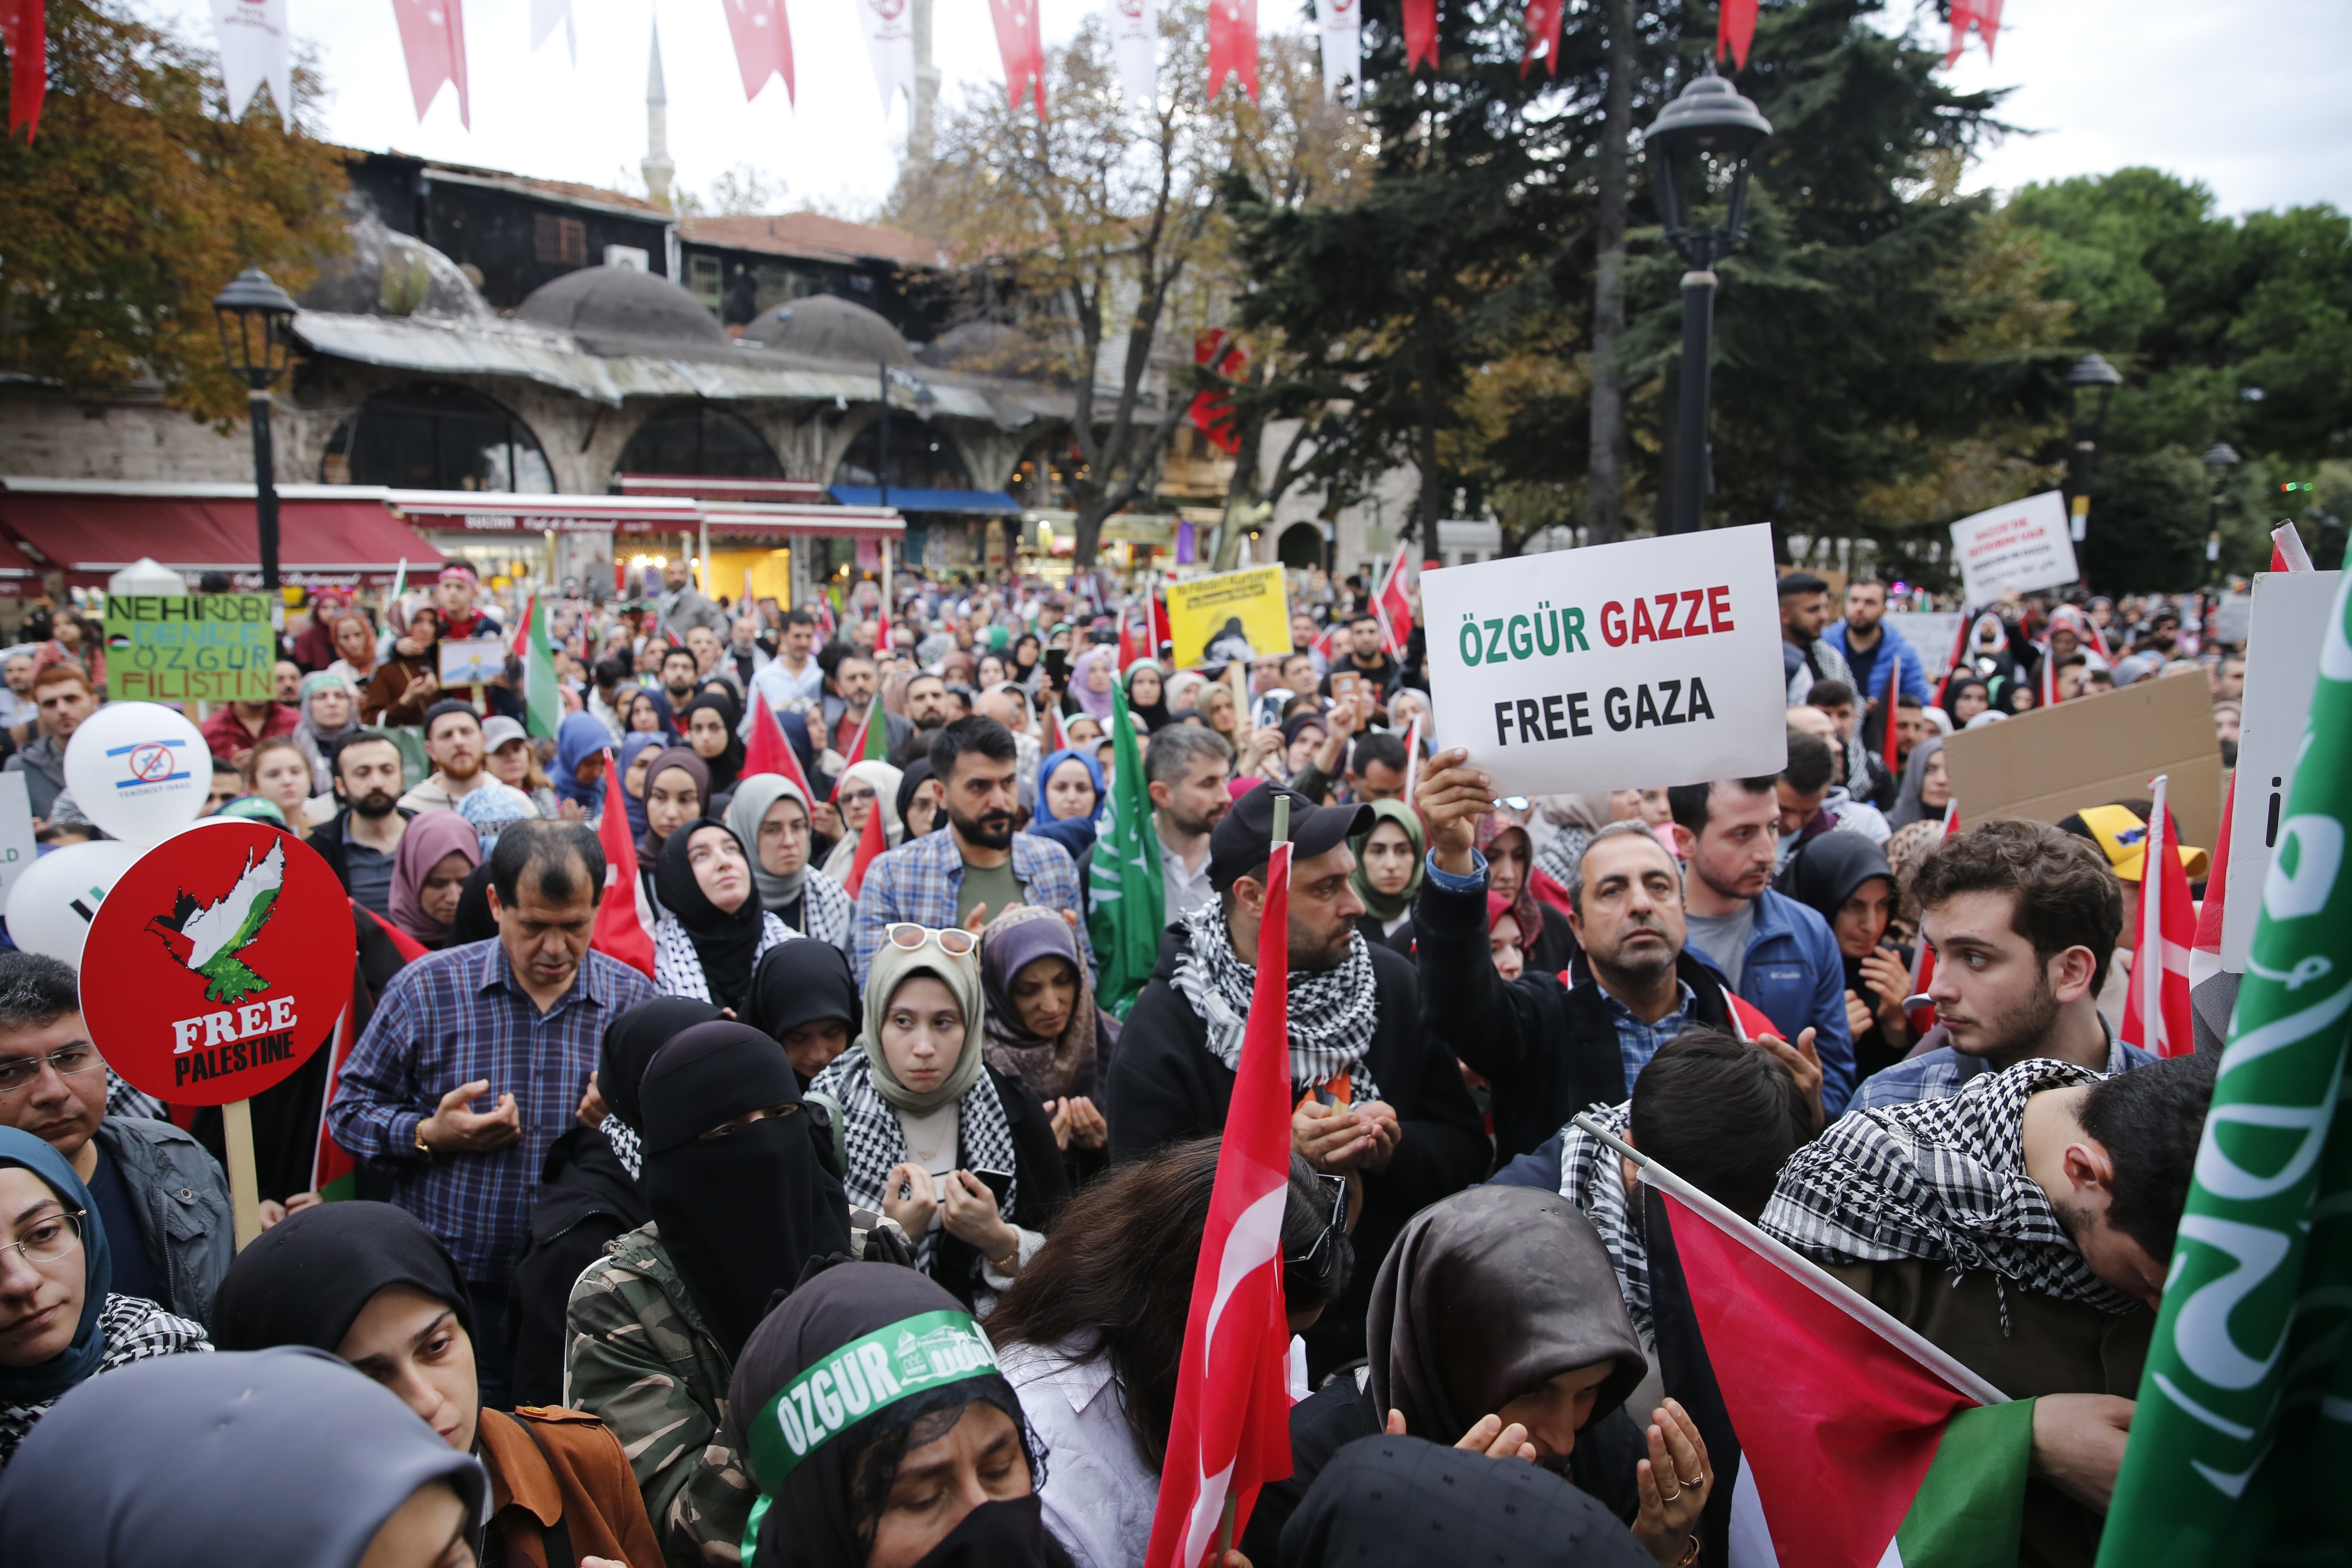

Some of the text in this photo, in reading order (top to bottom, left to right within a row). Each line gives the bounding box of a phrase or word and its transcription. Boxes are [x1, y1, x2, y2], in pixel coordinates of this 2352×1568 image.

[1460, 586, 1734, 666] ÖZGÜR GAZZE
[1494, 677, 1715, 746] FREE GAZA
[172, 995, 297, 1054] FREE
[175, 1031, 295, 1087] PALESTINE
[777, 1341, 902, 1456] ÖZGÜR
